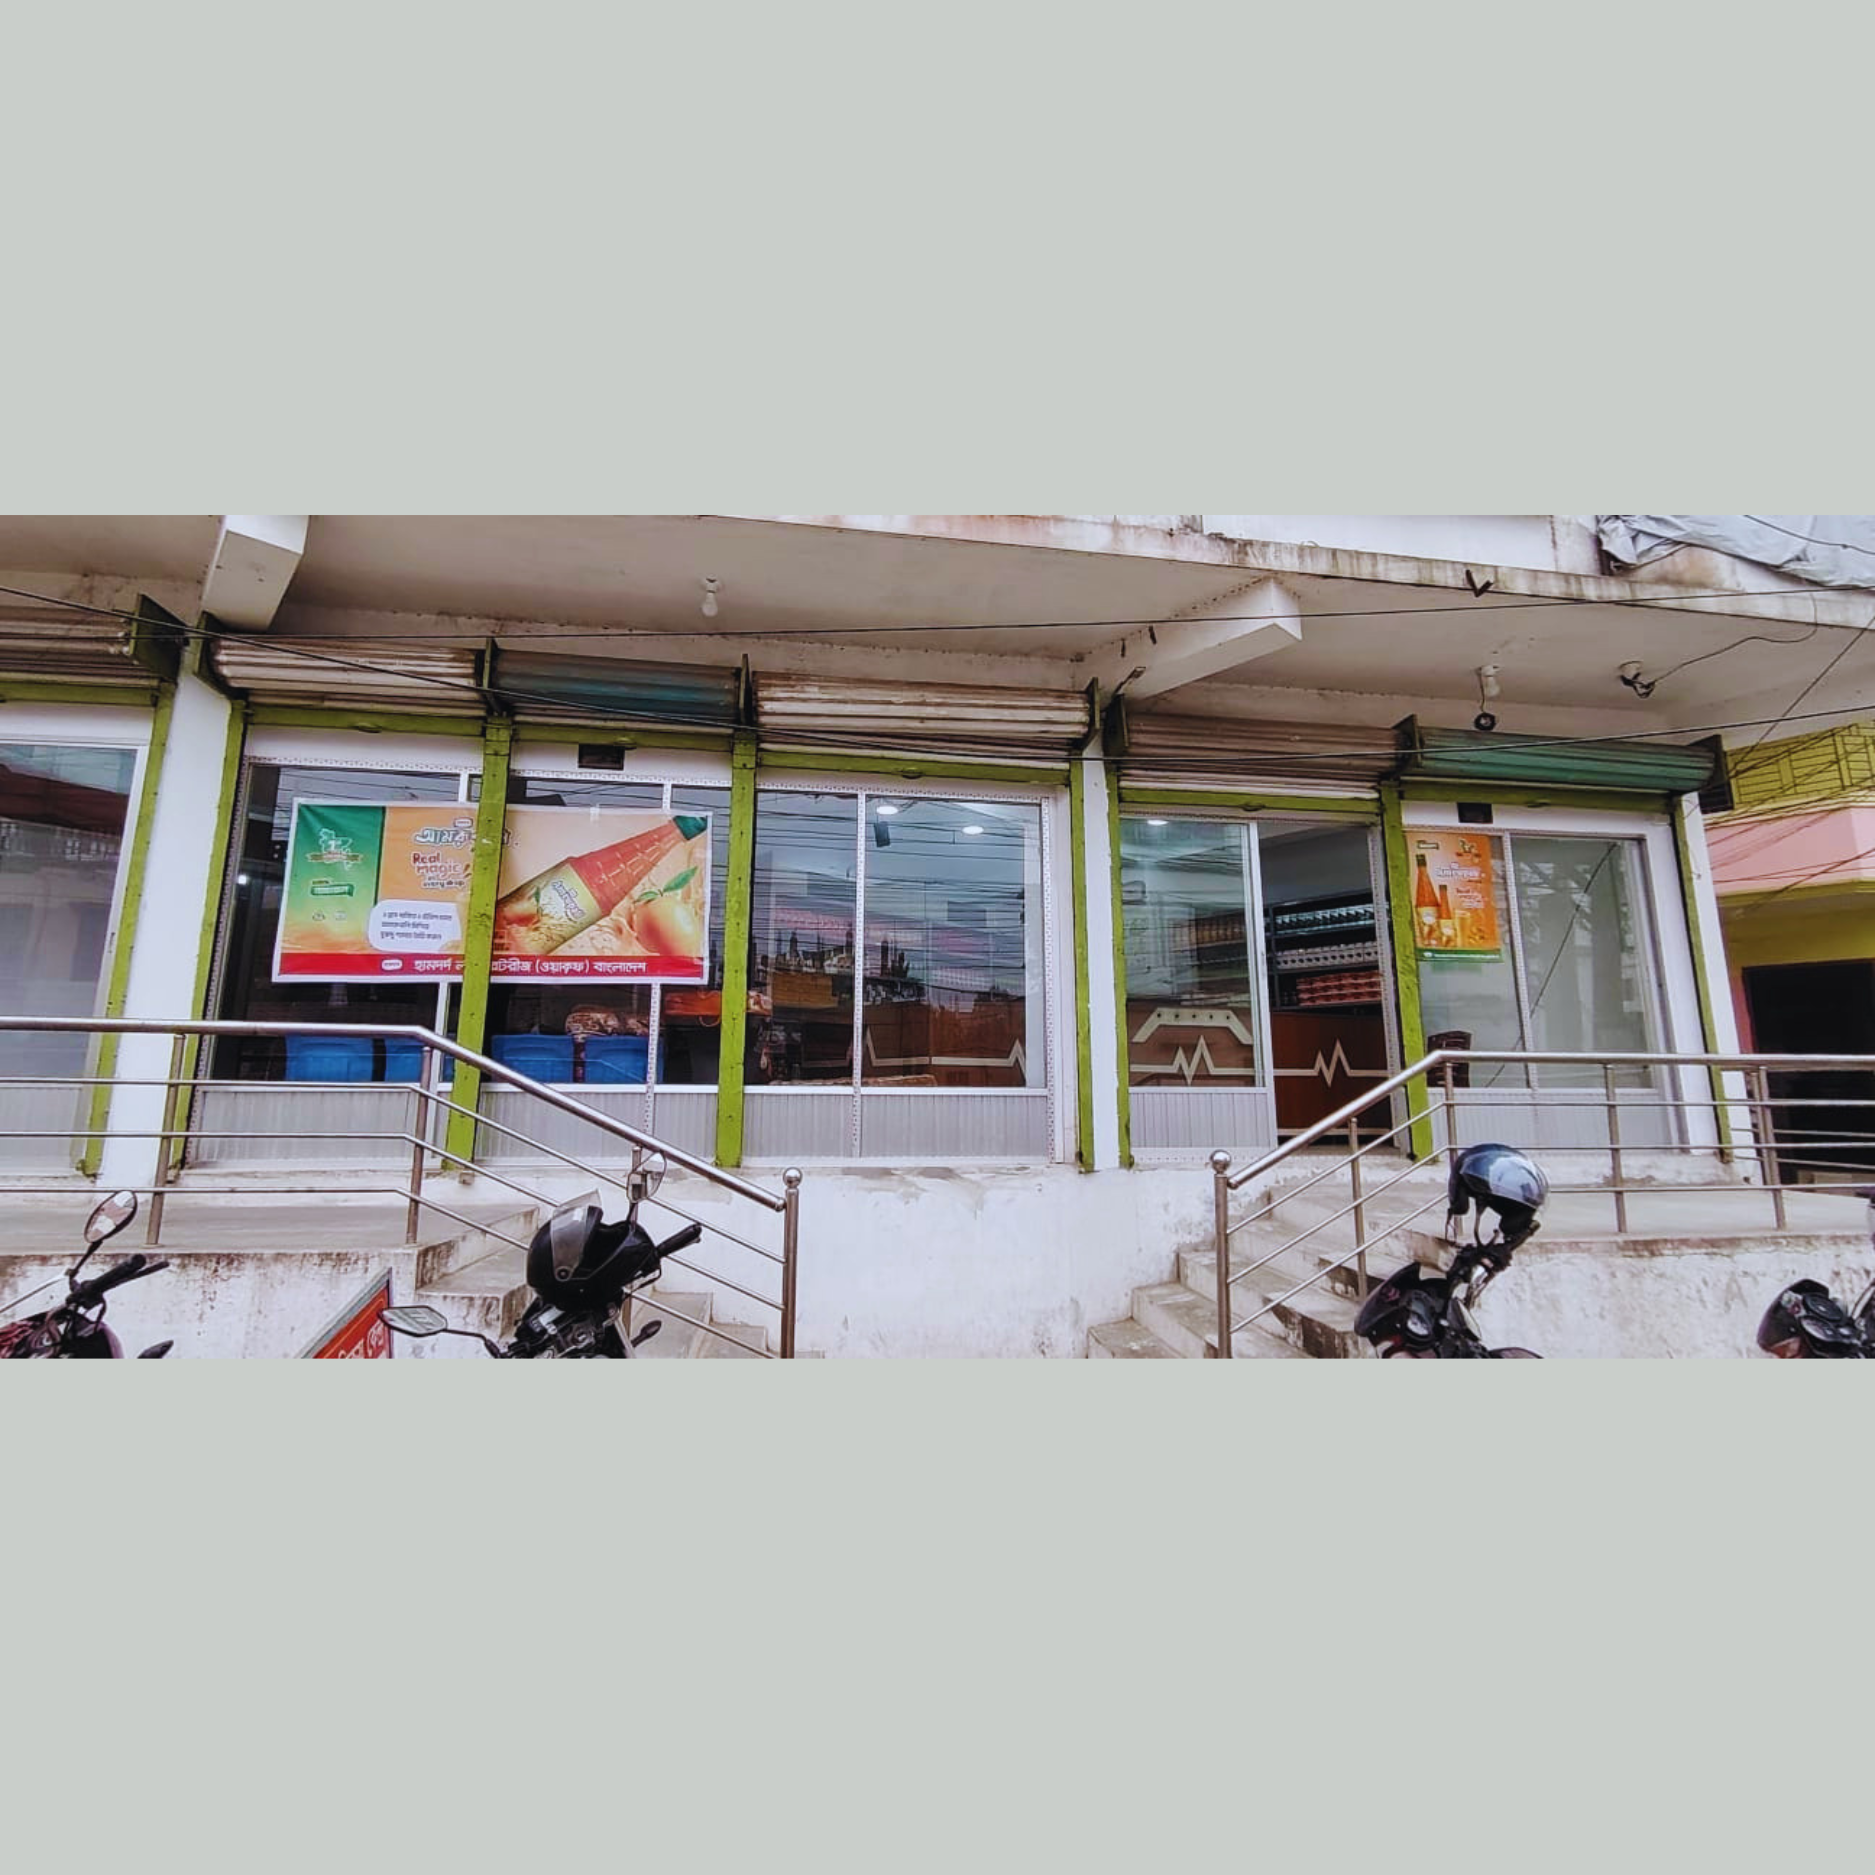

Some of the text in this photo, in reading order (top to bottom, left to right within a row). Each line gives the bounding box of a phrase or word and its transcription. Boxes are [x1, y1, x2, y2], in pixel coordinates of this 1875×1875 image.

[413, 853, 440, 864] Real
[417, 862, 460, 878] magic
[592, 961, 648, 974] বাংলাদেশ
